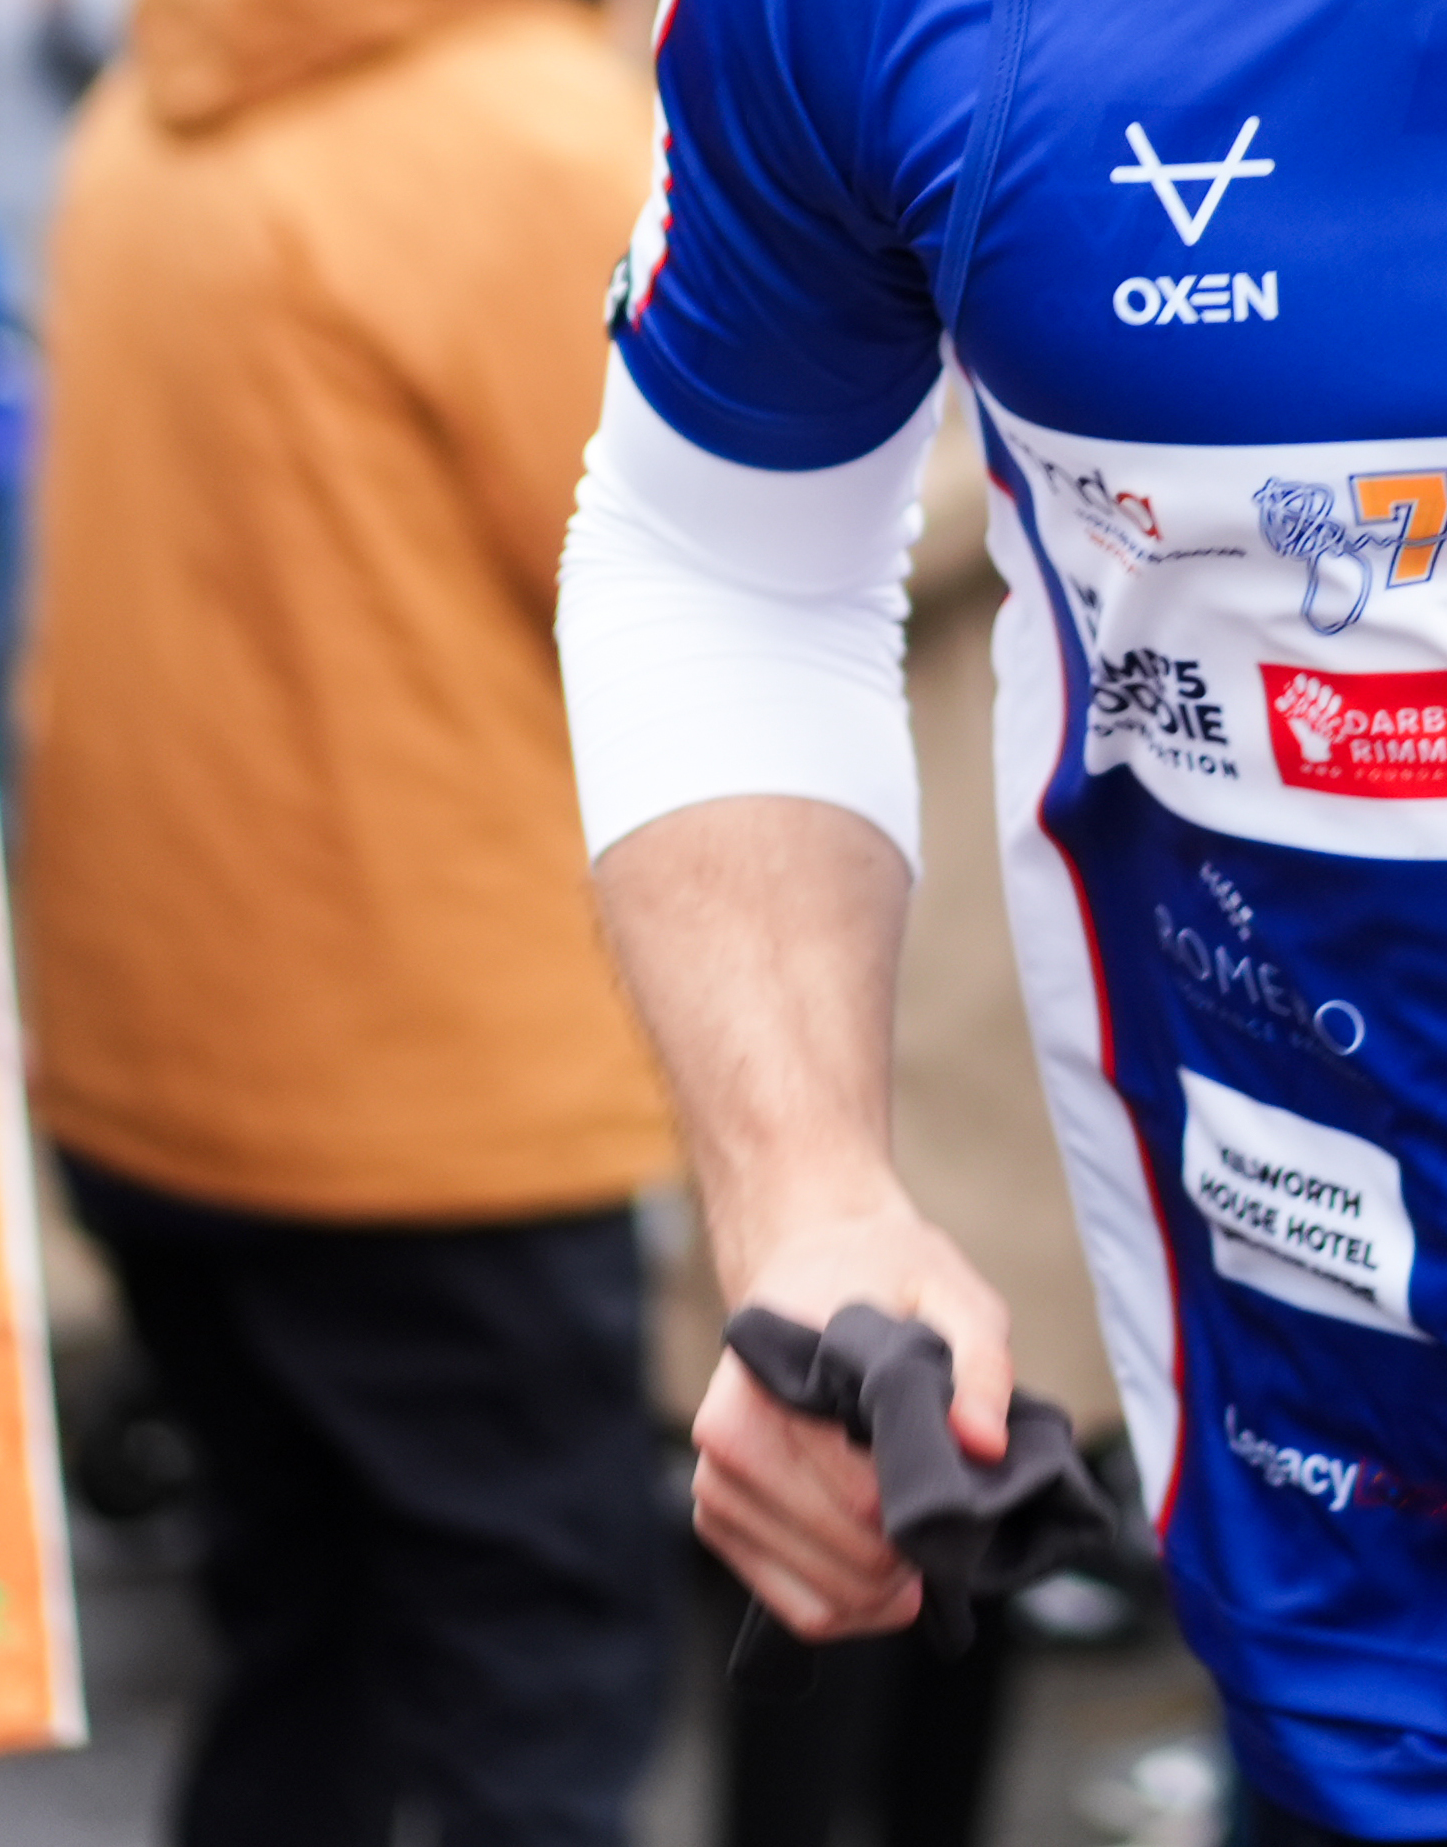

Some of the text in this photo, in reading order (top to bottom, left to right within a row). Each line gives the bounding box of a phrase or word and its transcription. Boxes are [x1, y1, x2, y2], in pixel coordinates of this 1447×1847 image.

[1113, 270, 1280, 327] OXEN
[1201, 1171, 1279, 1236] HOUSE
[1285, 1215, 1378, 1271] HOTEL
